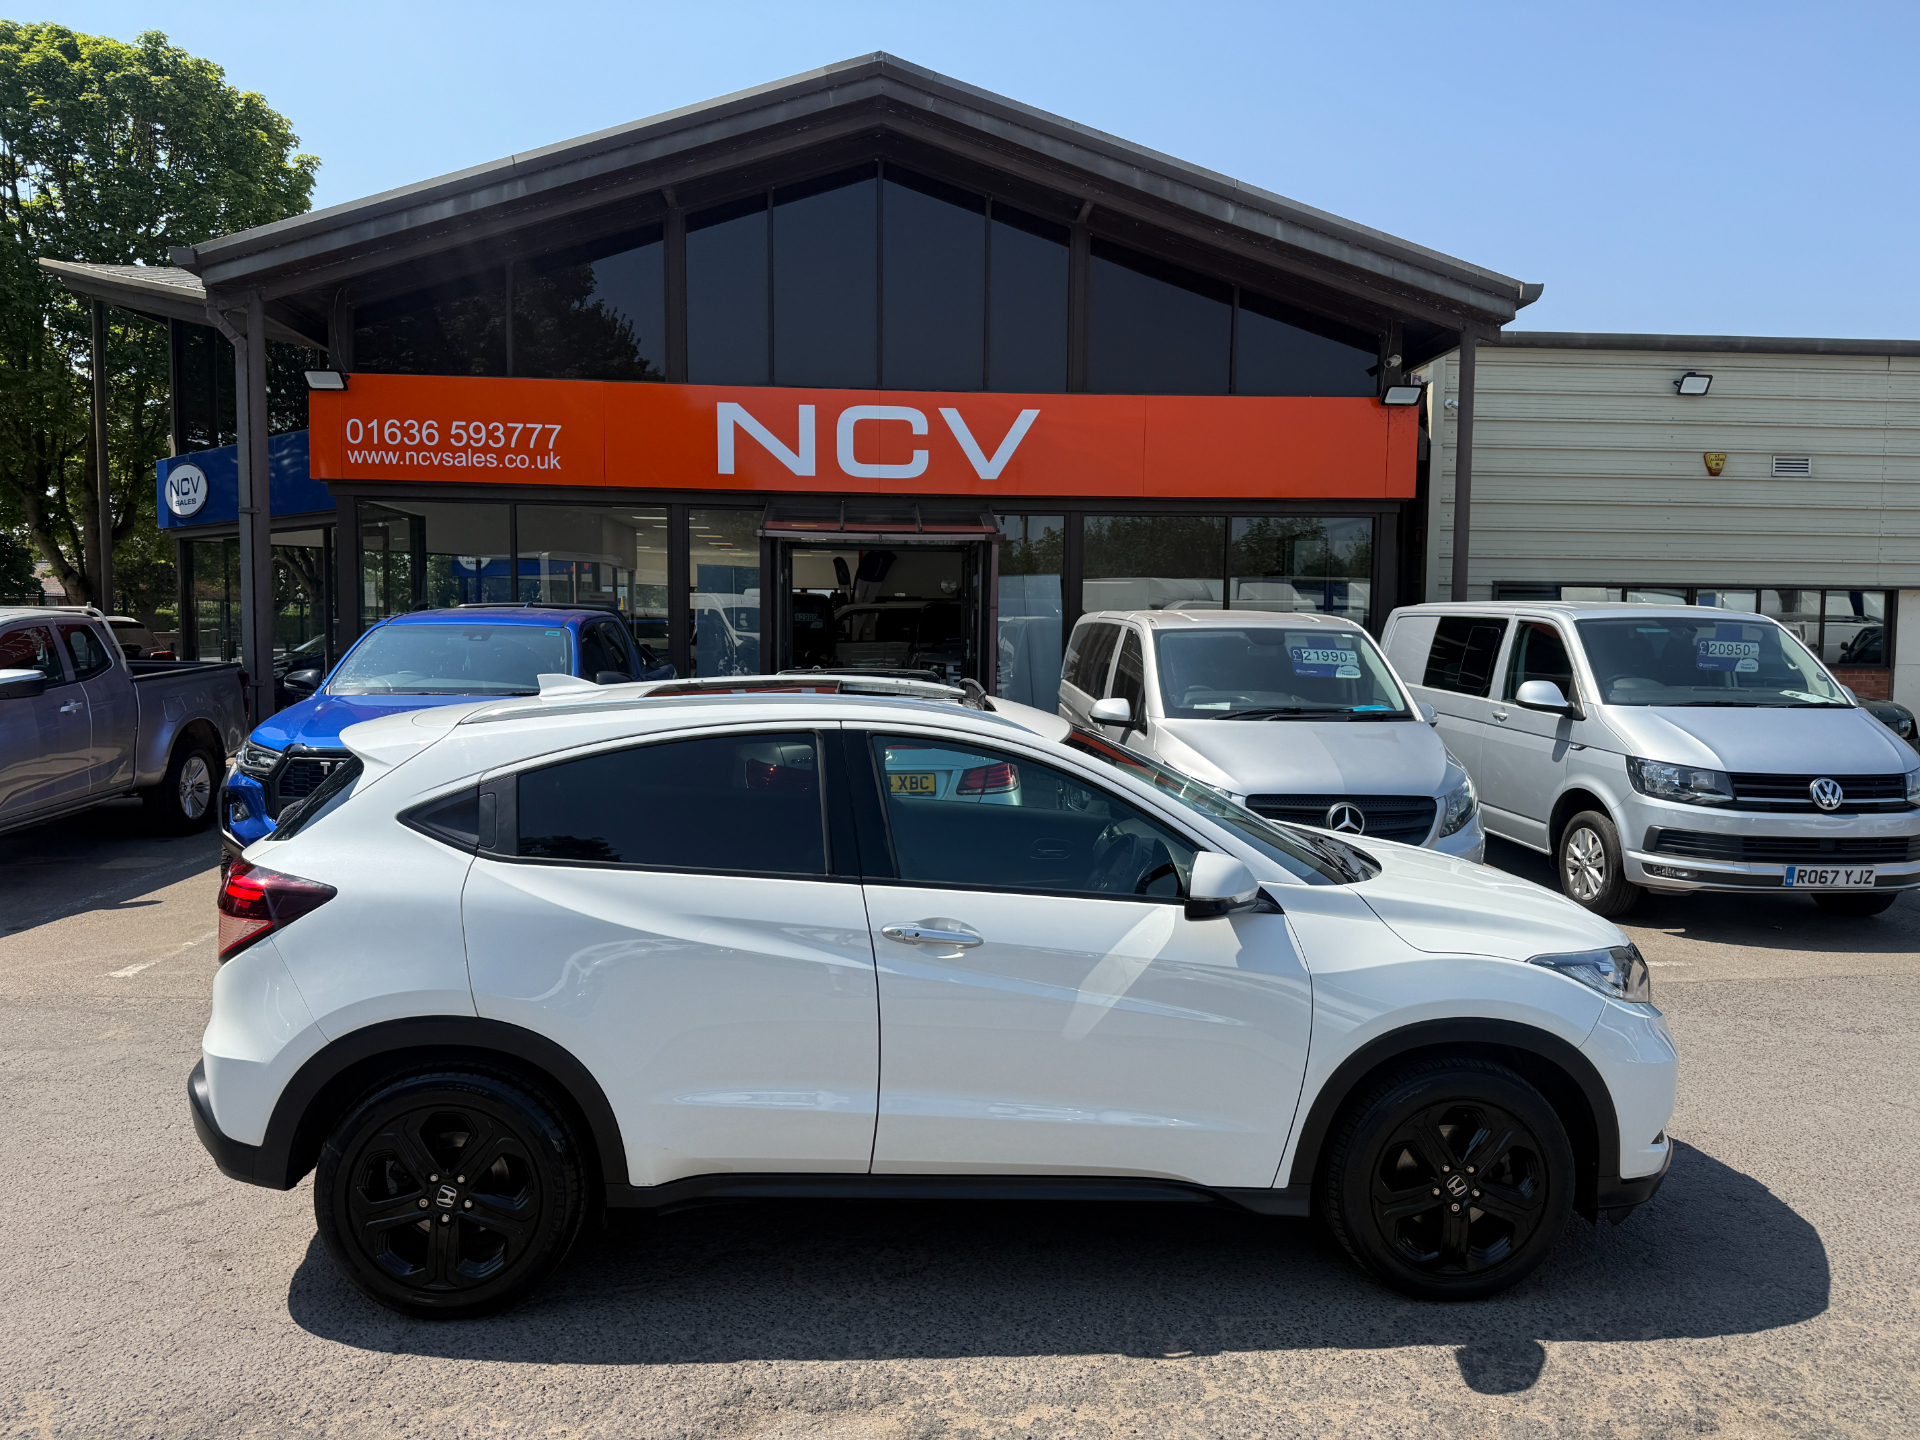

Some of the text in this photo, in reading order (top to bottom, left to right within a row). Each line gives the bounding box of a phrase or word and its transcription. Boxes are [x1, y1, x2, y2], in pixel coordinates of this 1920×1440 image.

[345, 418, 562, 450] 01636 593777
[717, 402, 1041, 480] NCV
[347, 448, 562, 471] www.ncvsales.co.uk
[169, 475, 200, 498] NCV
[175, 498, 197, 507] SALES
[898, 776, 930, 790] XBC
[1796, 869, 1874, 885] RO67 YJZ
